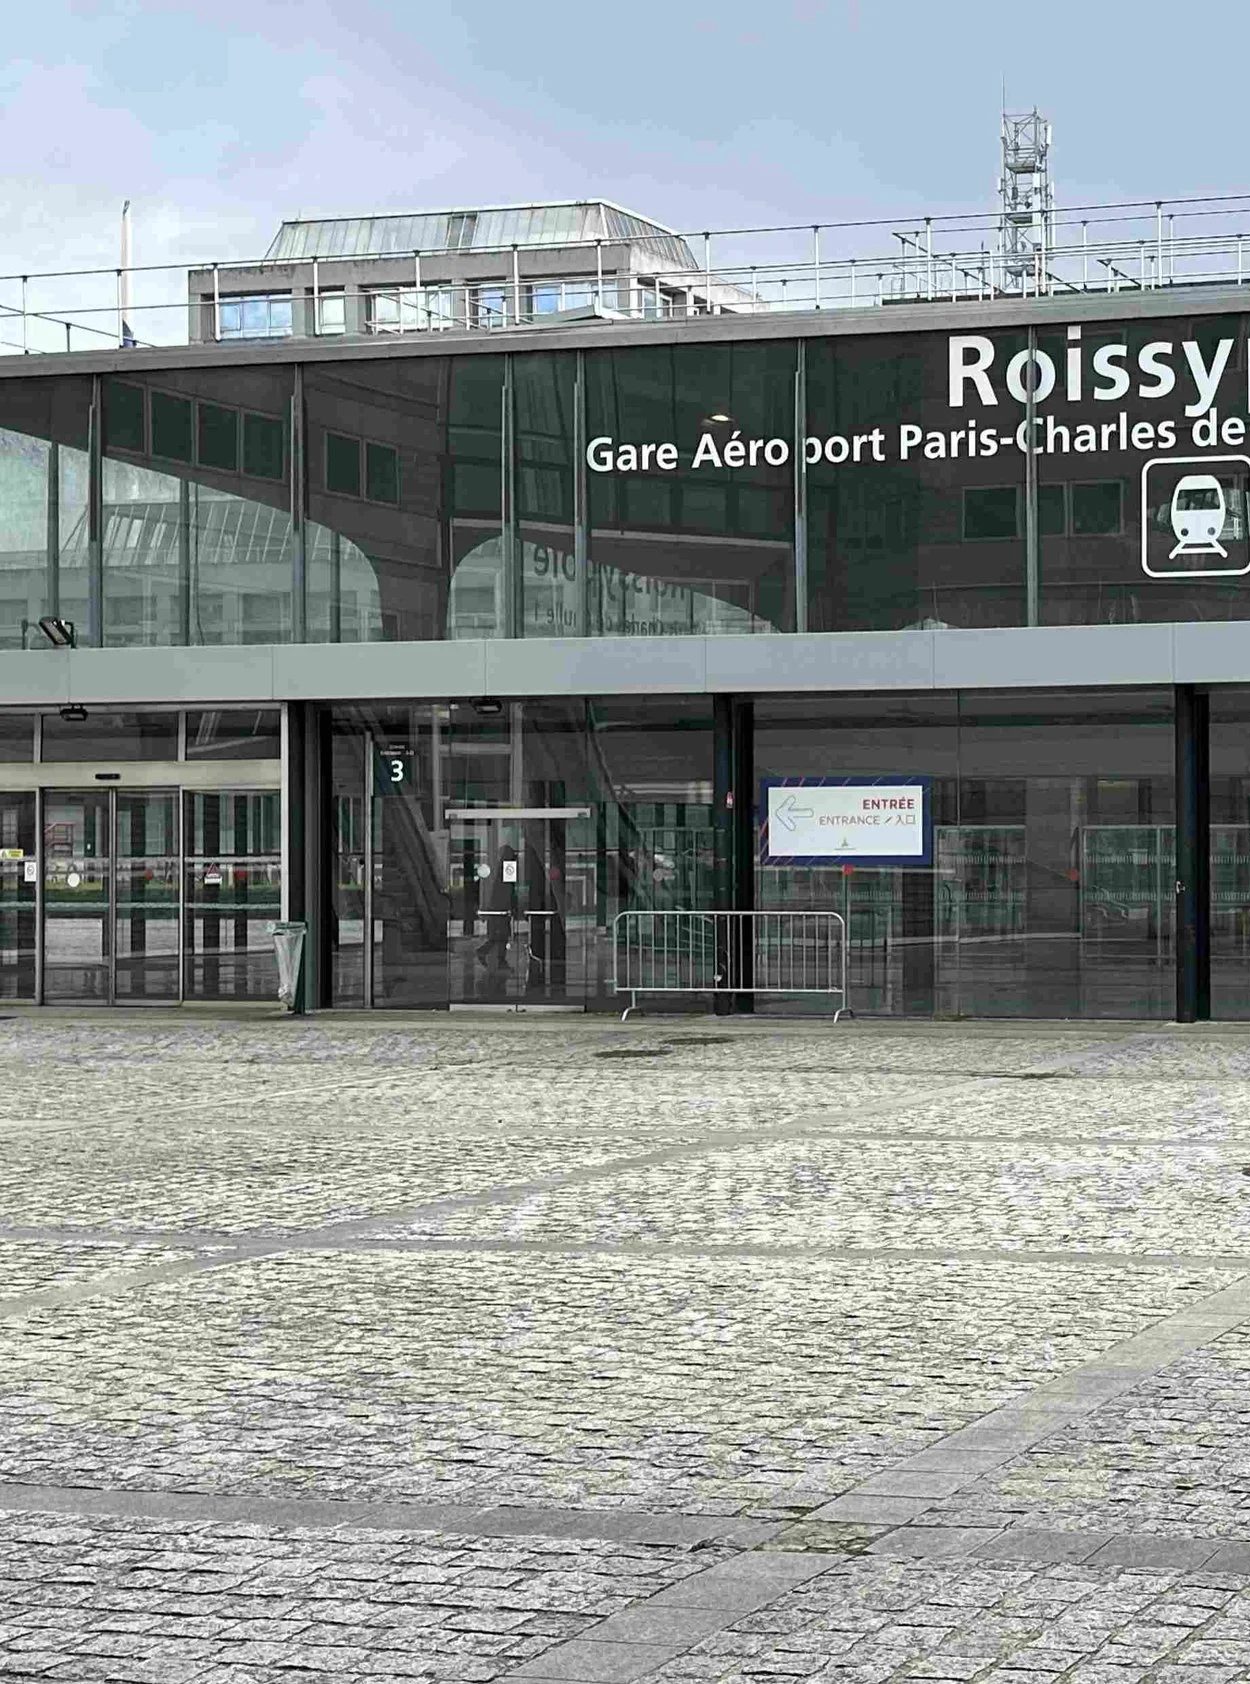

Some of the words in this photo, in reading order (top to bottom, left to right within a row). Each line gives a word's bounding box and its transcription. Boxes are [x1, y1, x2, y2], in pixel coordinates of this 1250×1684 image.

[586, 436, 679, 472] Gare
[691, 427, 886, 473] Aéroport
[899, 412, 1177, 460] Paris-Charles
[1191, 408, 1246, 447] de
[391, 760, 404, 782] 3
[863, 797, 915, 810] ENTRÉE
[819, 815, 880, 826] ENTRANCE
